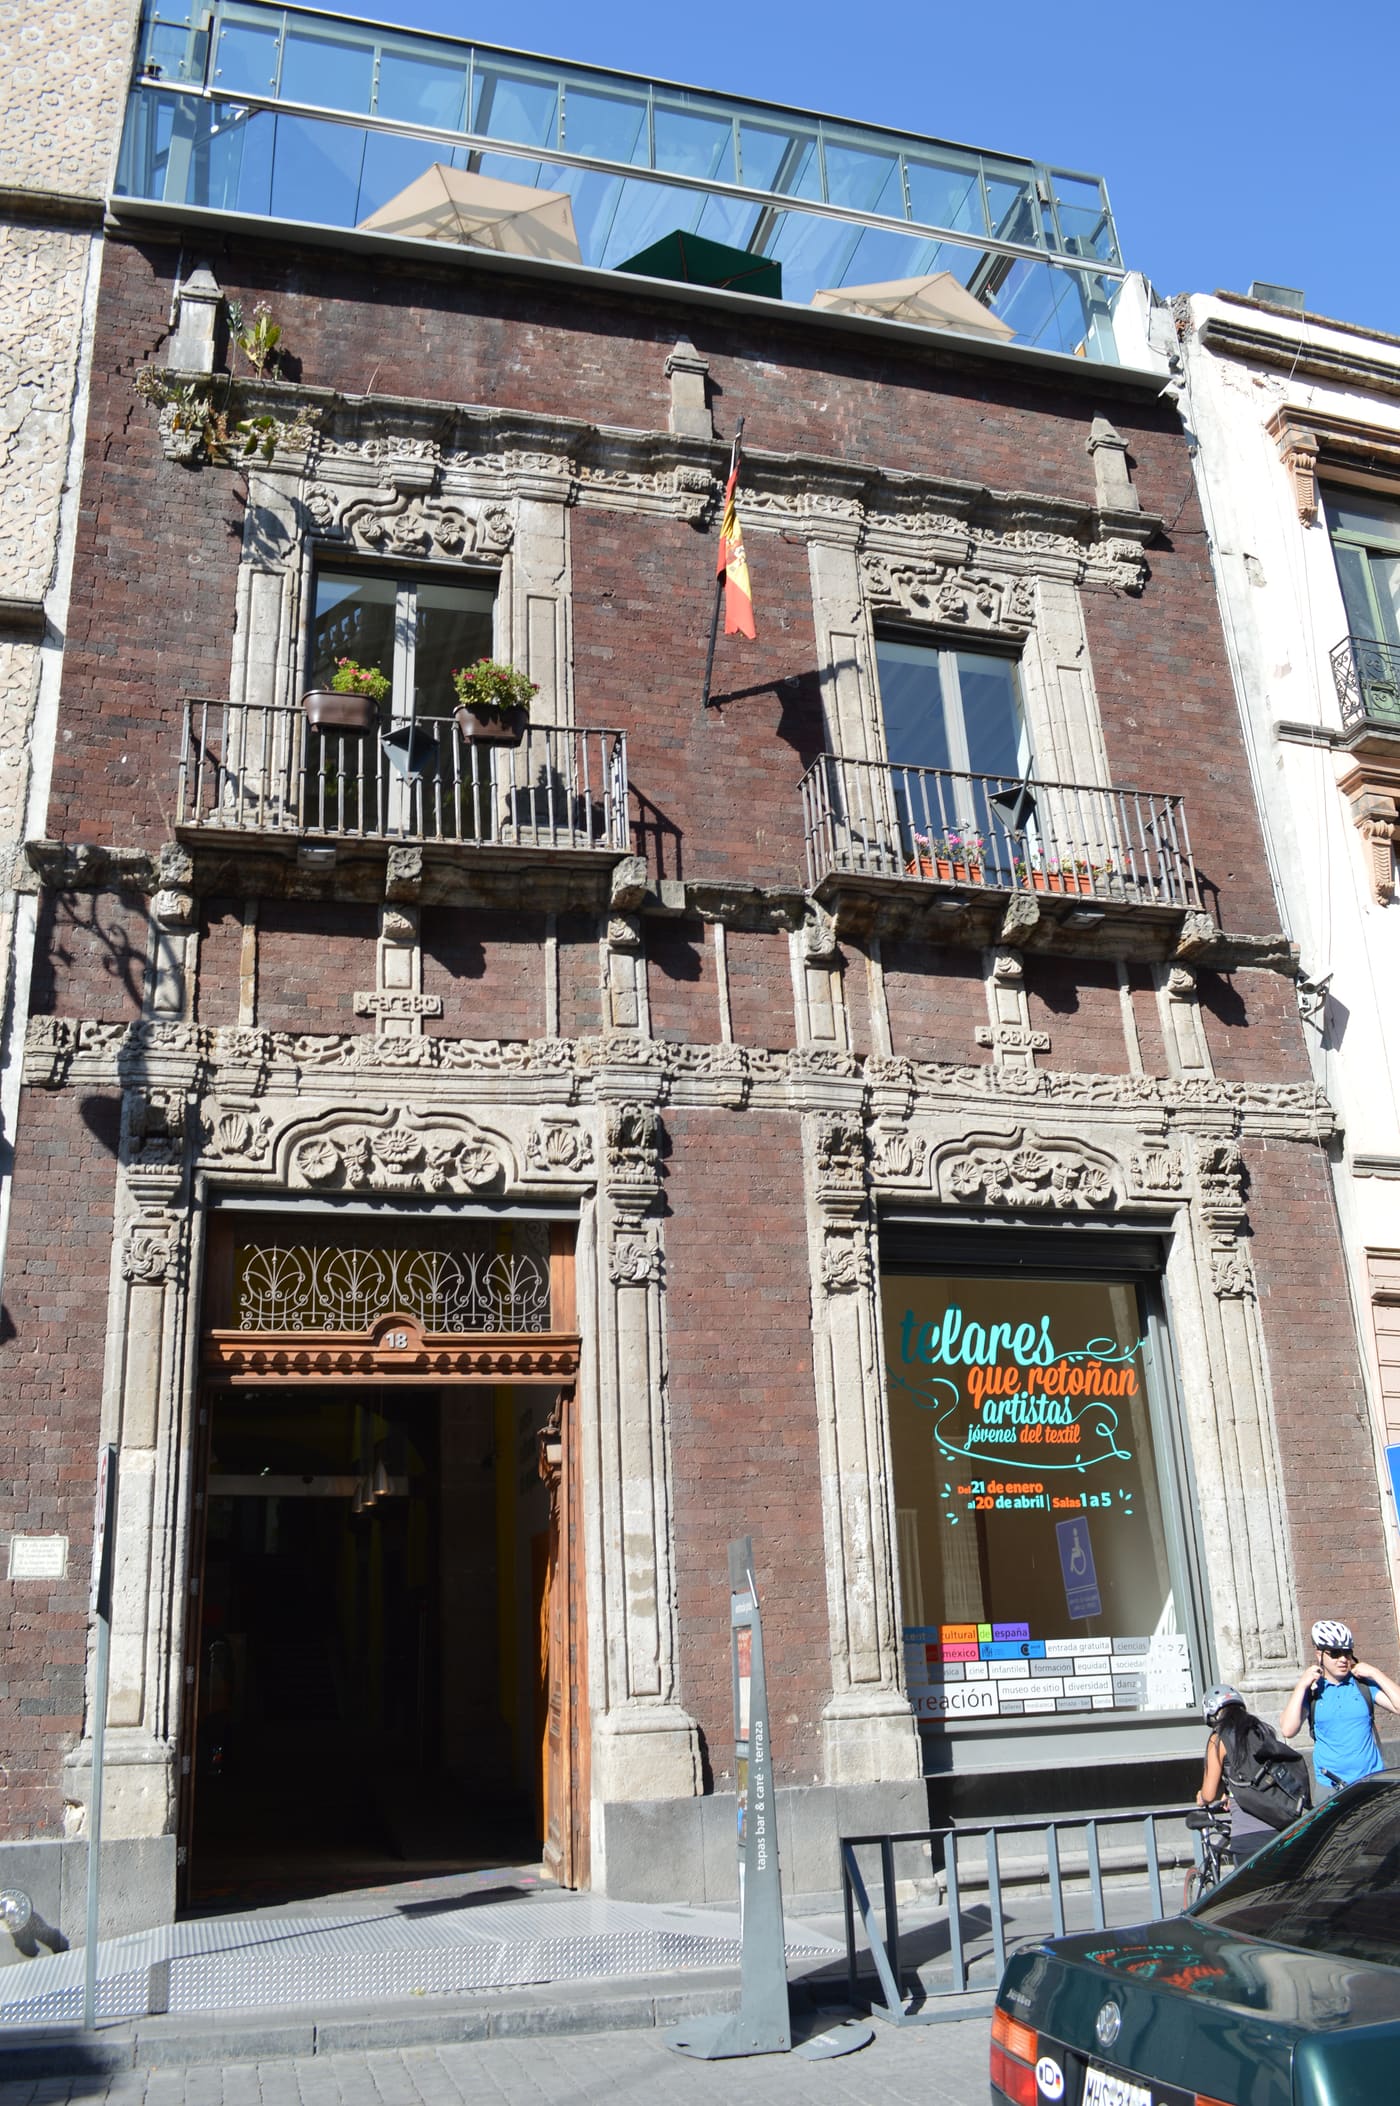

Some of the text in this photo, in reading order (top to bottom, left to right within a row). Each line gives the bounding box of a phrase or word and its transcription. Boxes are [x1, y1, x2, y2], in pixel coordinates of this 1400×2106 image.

[385, 1332, 408, 1349] 18
[900, 1303, 1055, 1366] telares
[968, 1359, 1139, 1410] que retoñan
[983, 1391, 1073, 1424] artistas
[964, 1423, 1081, 1450] jóvenes del textil
[971, 1481, 985, 1494] 21
[987, 1480, 1004, 1494] de
[1006, 1482, 1043, 1494] enero
[976, 1496, 994, 1510] 20
[995, 1495, 1012, 1509] de
[1014, 1494, 1044, 1508] abril
[1089, 1495, 1099, 1507] a
[1101, 1492, 1112, 1507] 5
[979, 1627, 991, 1638] de
[994, 1628, 1028, 1640] españa
[943, 1649, 977, 1658] méxico
[1048, 1644, 1078, 1653] entrada
[1079, 1641, 1110, 1652] gratuita
[969, 1666, 985, 1674] cine
[992, 1665, 1026, 1674] infantiles
[1034, 1663, 1072, 1673] formación
[1077, 1661, 1107, 1671] equidad
[1002, 1683, 1060, 1695] museo de sitio
[1068, 1680, 1109, 1691] diversidad
[913, 1688, 993, 1711] reación
[754, 1720, 764, 1763] terraza
[755, 1801, 766, 1812] &
[755, 1815, 766, 1836] bar
[756, 1837, 768, 1871] tapas
[1044, 2063, 1055, 2086] D
